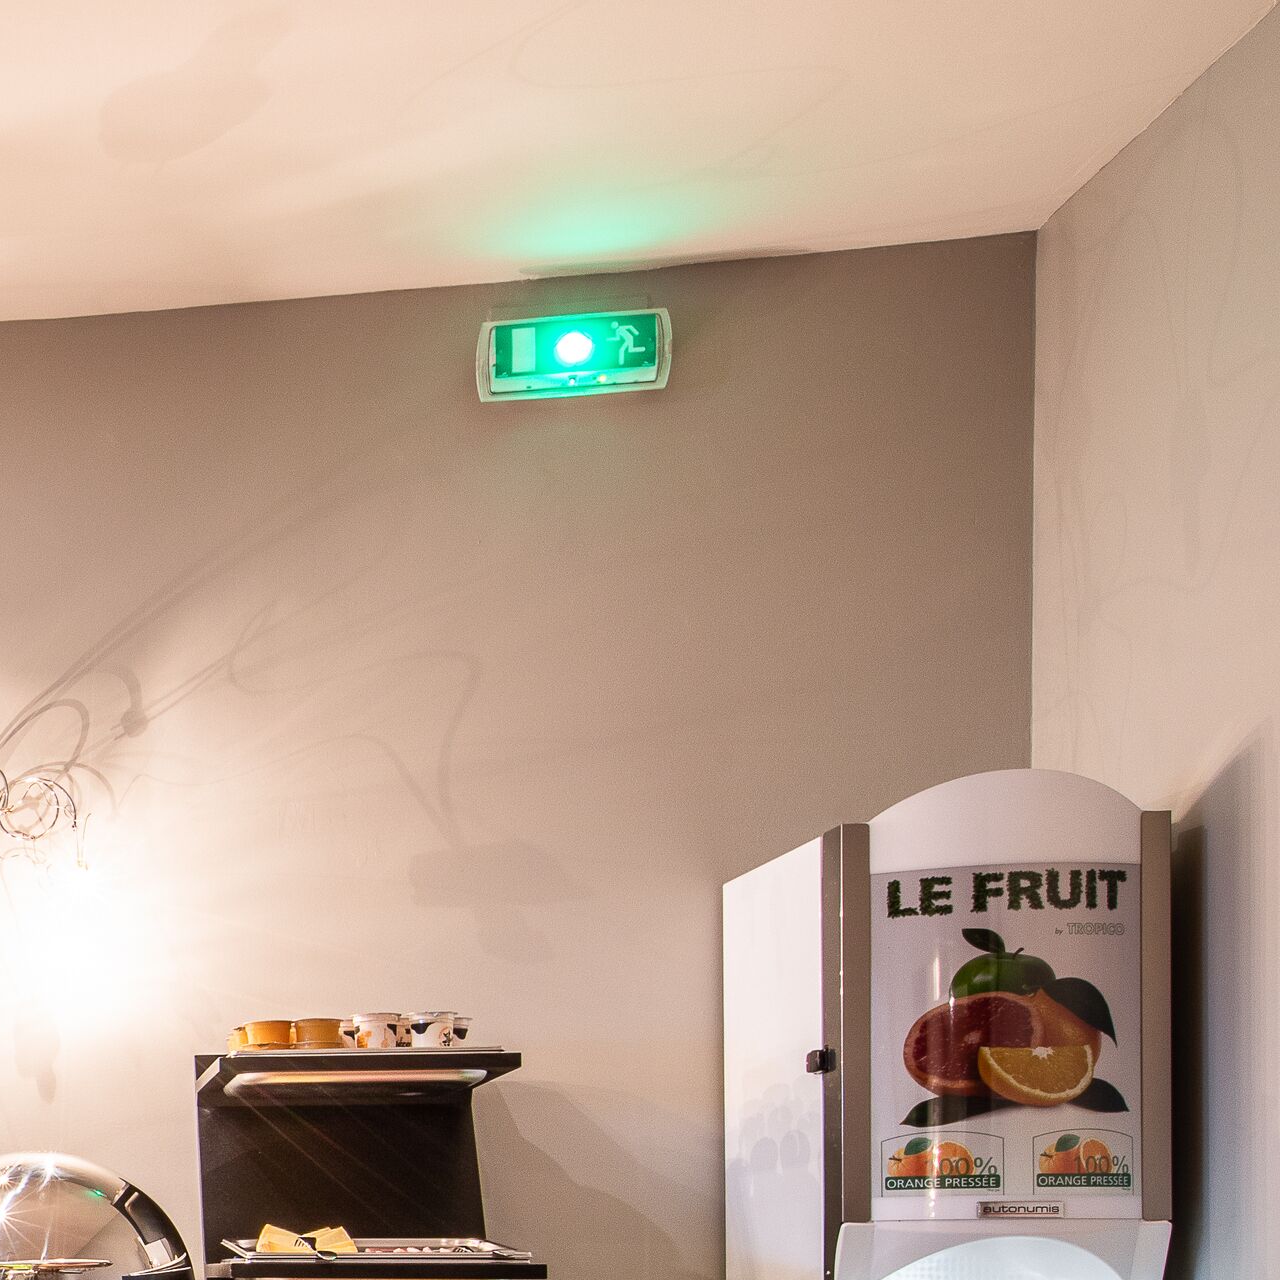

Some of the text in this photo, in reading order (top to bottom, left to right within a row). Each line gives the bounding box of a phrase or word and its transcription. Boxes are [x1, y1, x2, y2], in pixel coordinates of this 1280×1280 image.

[887, 868, 1127, 918] LE FRUIT
[1054, 922, 1126, 936] by TROPICO
[887, 1175, 997, 1189] ORANGE PRESSÉE
[1038, 1174, 1129, 1186] ORANGE PRESSÉE
[983, 1205, 1060, 1213] autonumis
